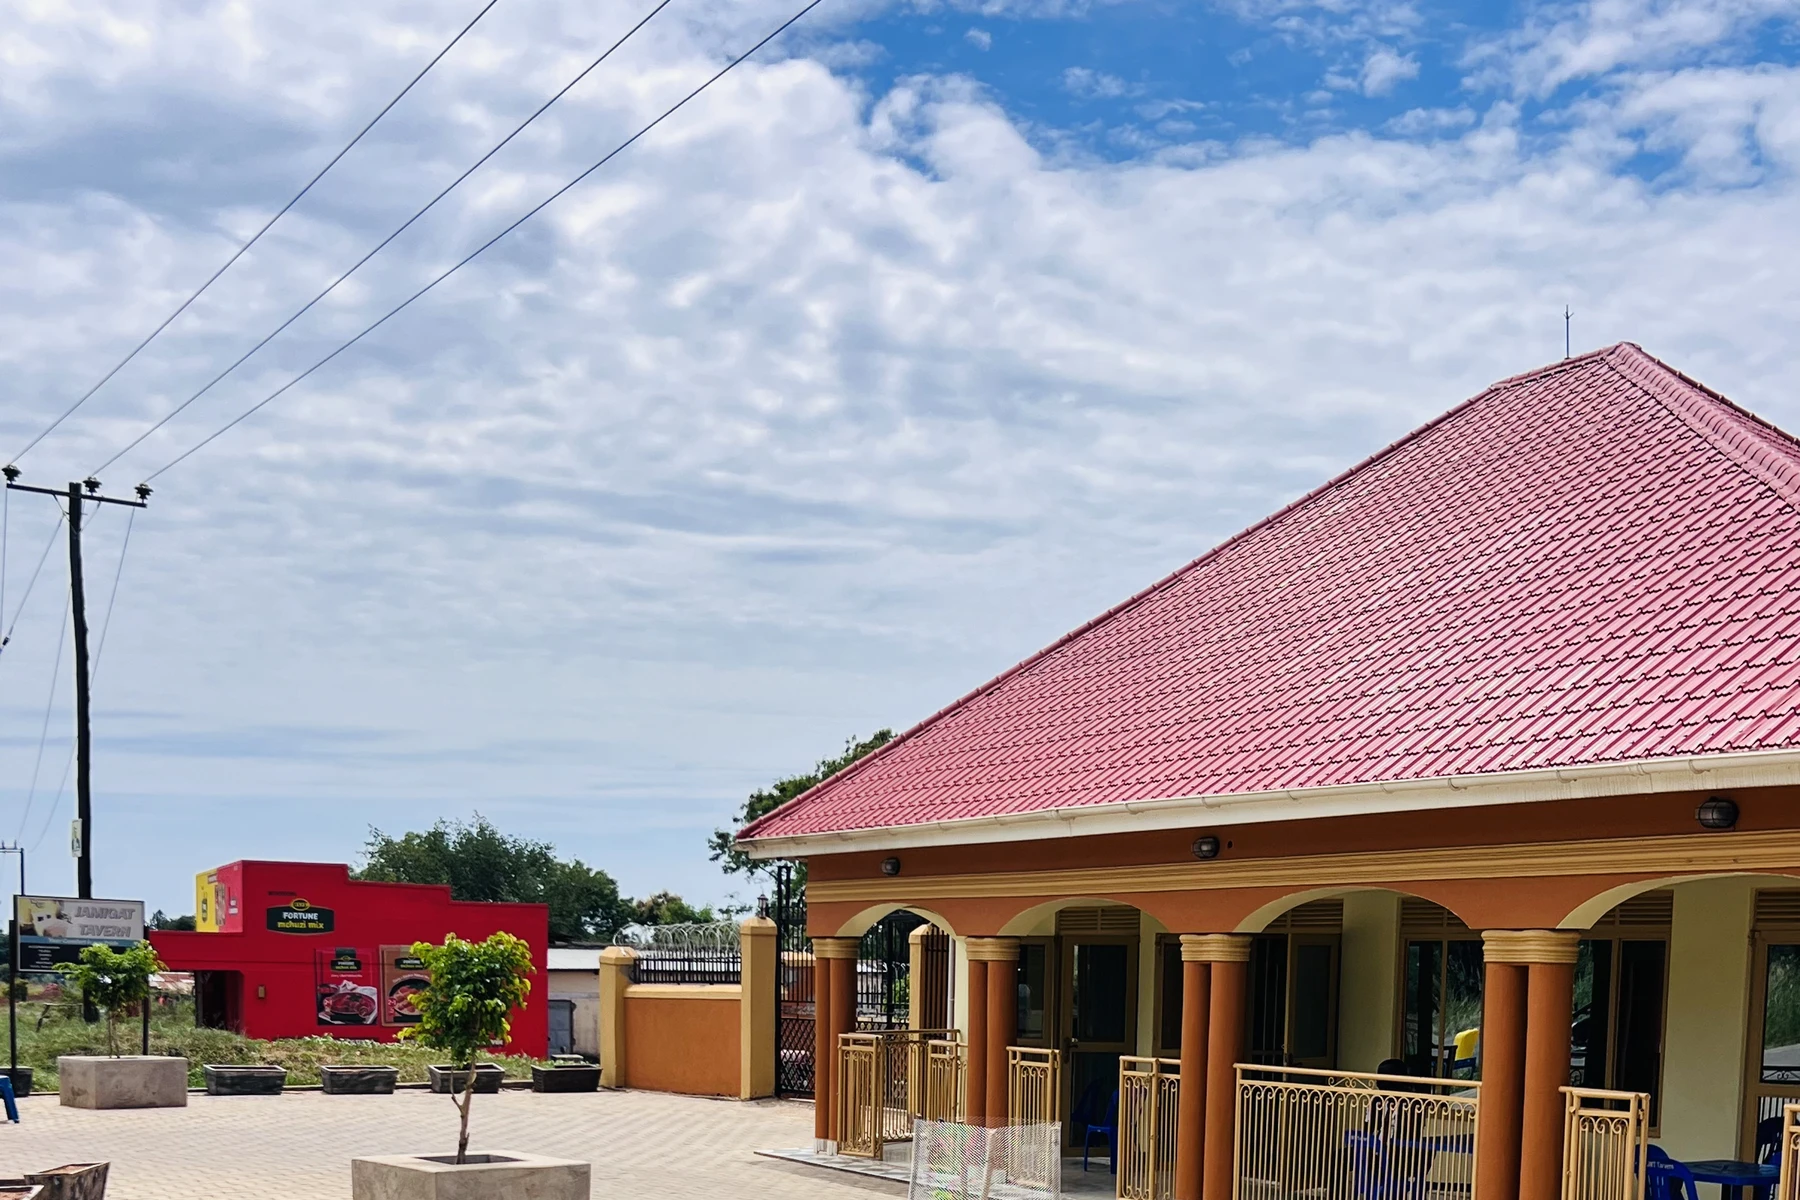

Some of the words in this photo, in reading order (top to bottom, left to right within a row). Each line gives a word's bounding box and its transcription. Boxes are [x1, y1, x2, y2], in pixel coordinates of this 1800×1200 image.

[282, 912, 319, 920] FORTUNE
[277, 920, 307, 929] mchuzi
[308, 921, 325, 929] mix
[80, 925, 131, 937] TAVERN
